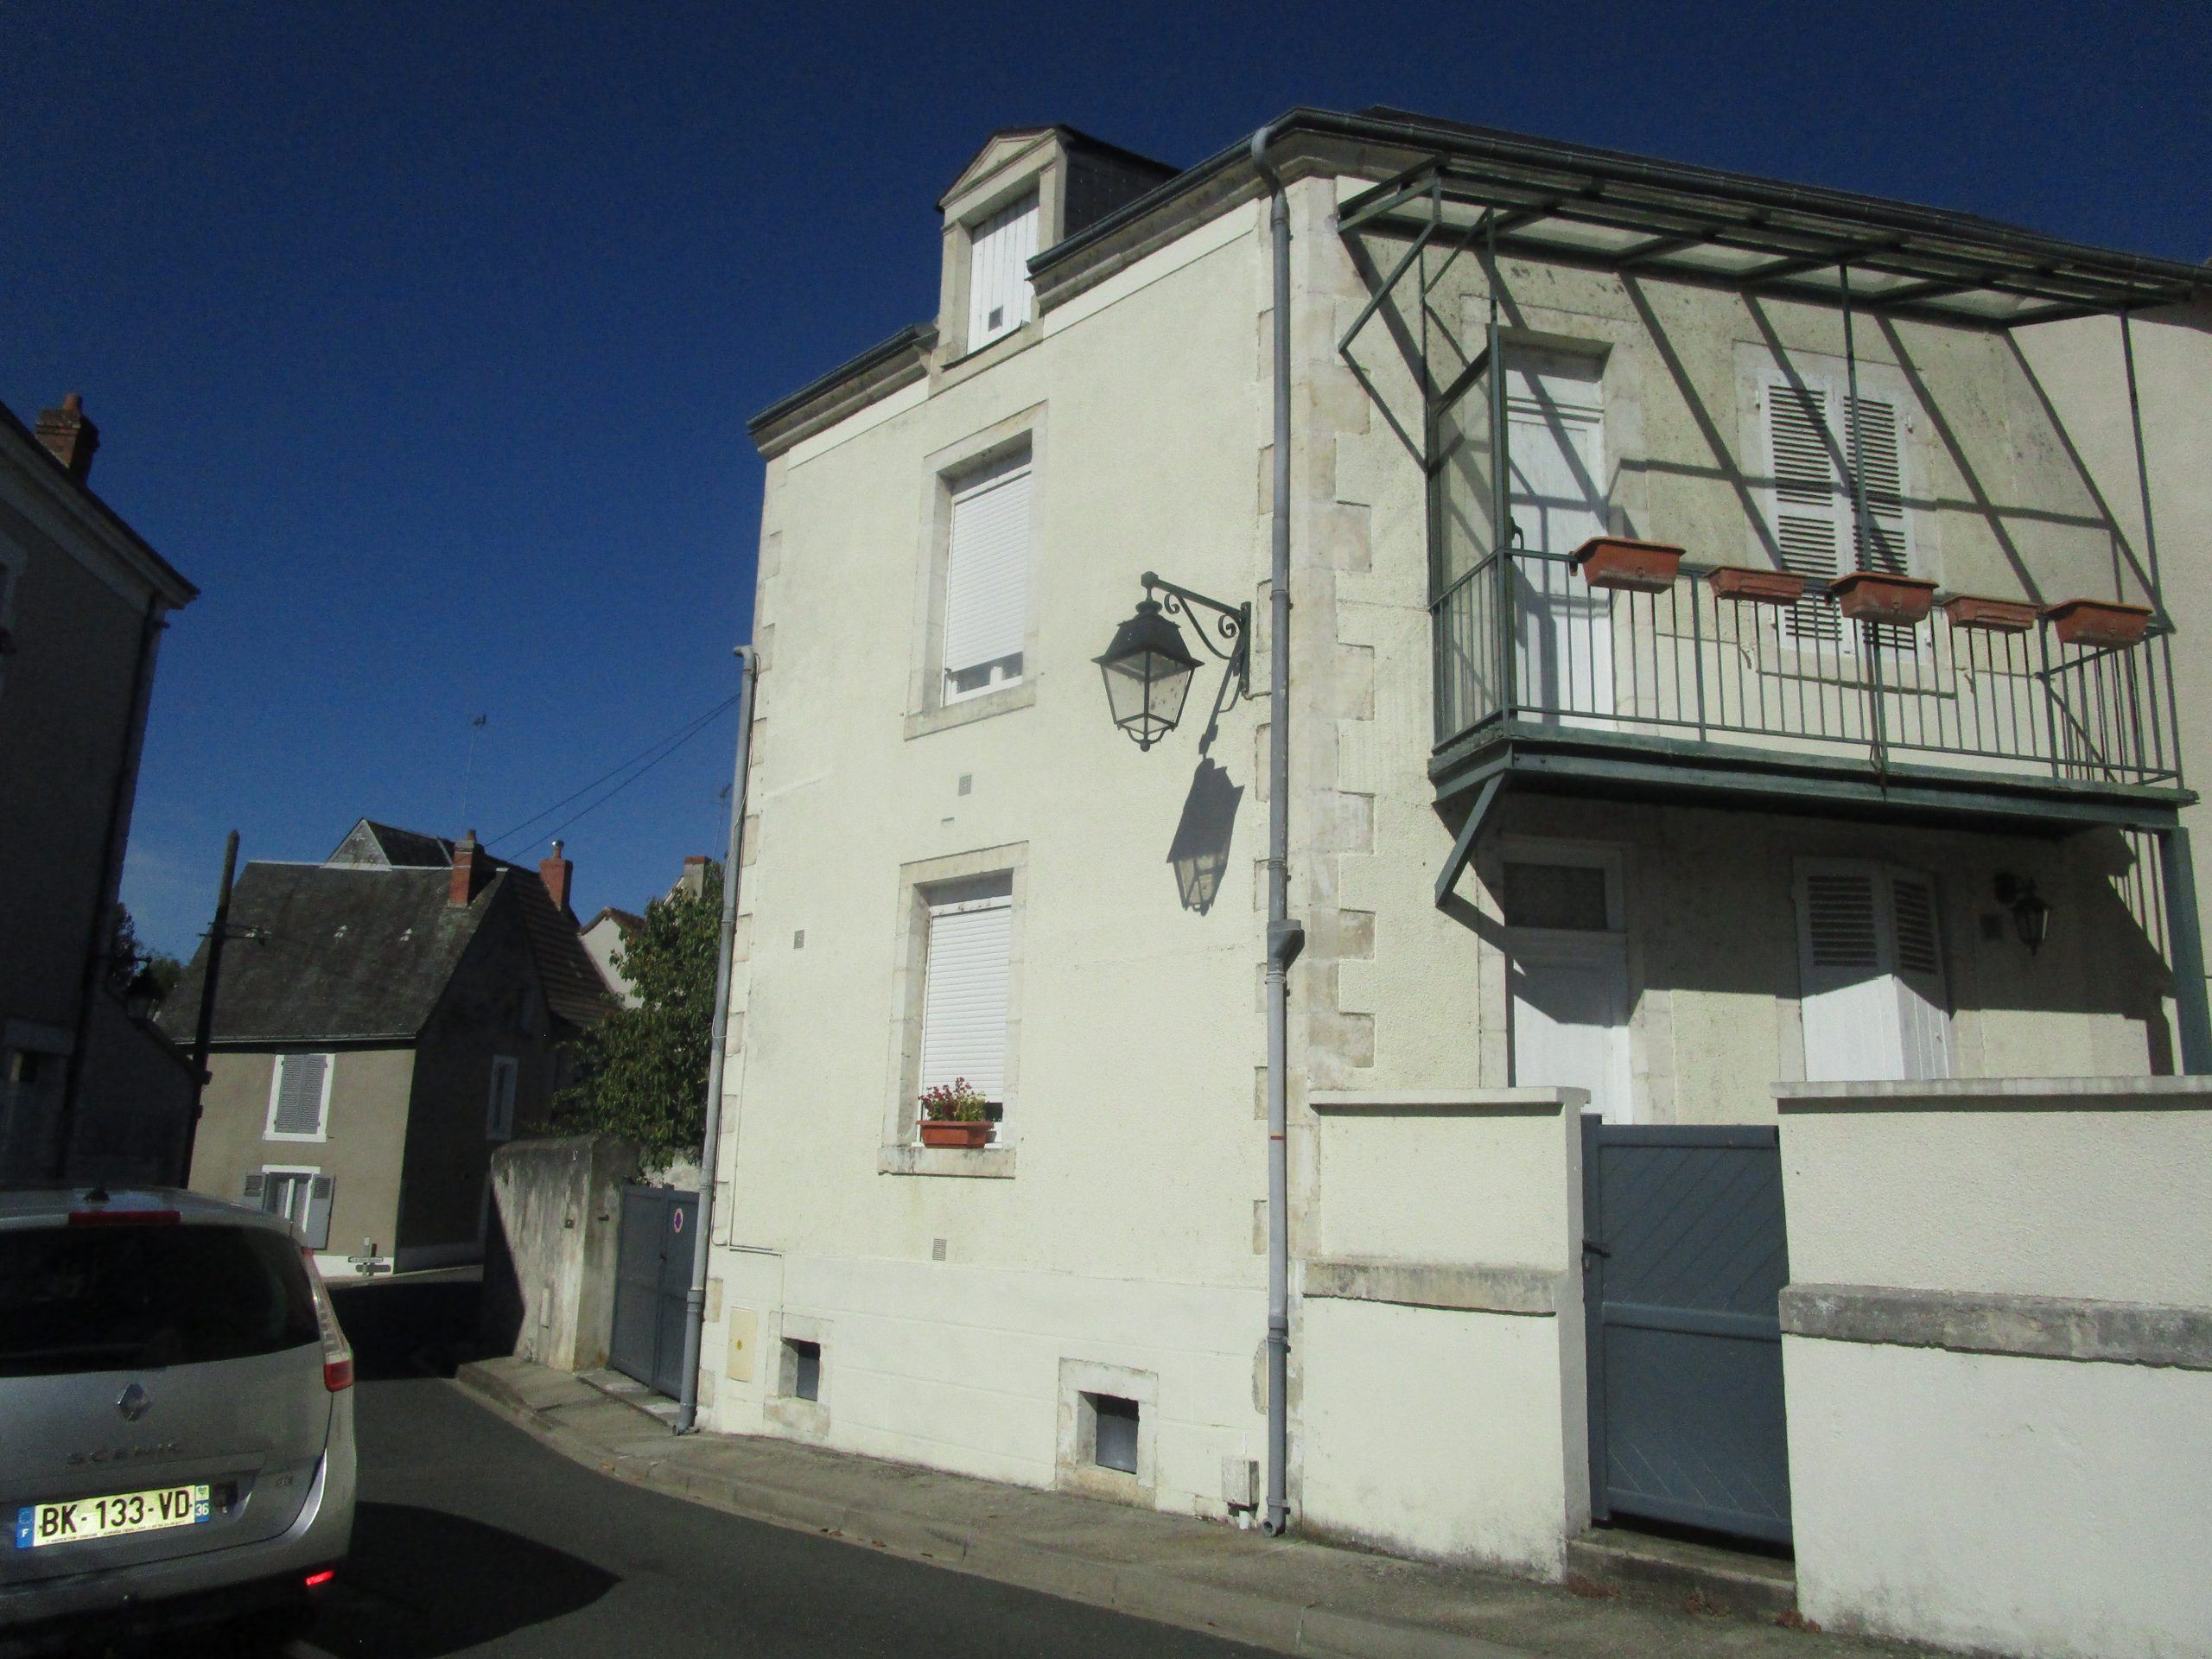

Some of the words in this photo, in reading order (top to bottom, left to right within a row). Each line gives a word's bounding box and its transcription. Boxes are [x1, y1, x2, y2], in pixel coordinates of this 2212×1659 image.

[41, 1490, 190, 1537] BK-133-VD
[195, 1503, 209, 1516] 36
[22, 1529, 29, 1537] F
